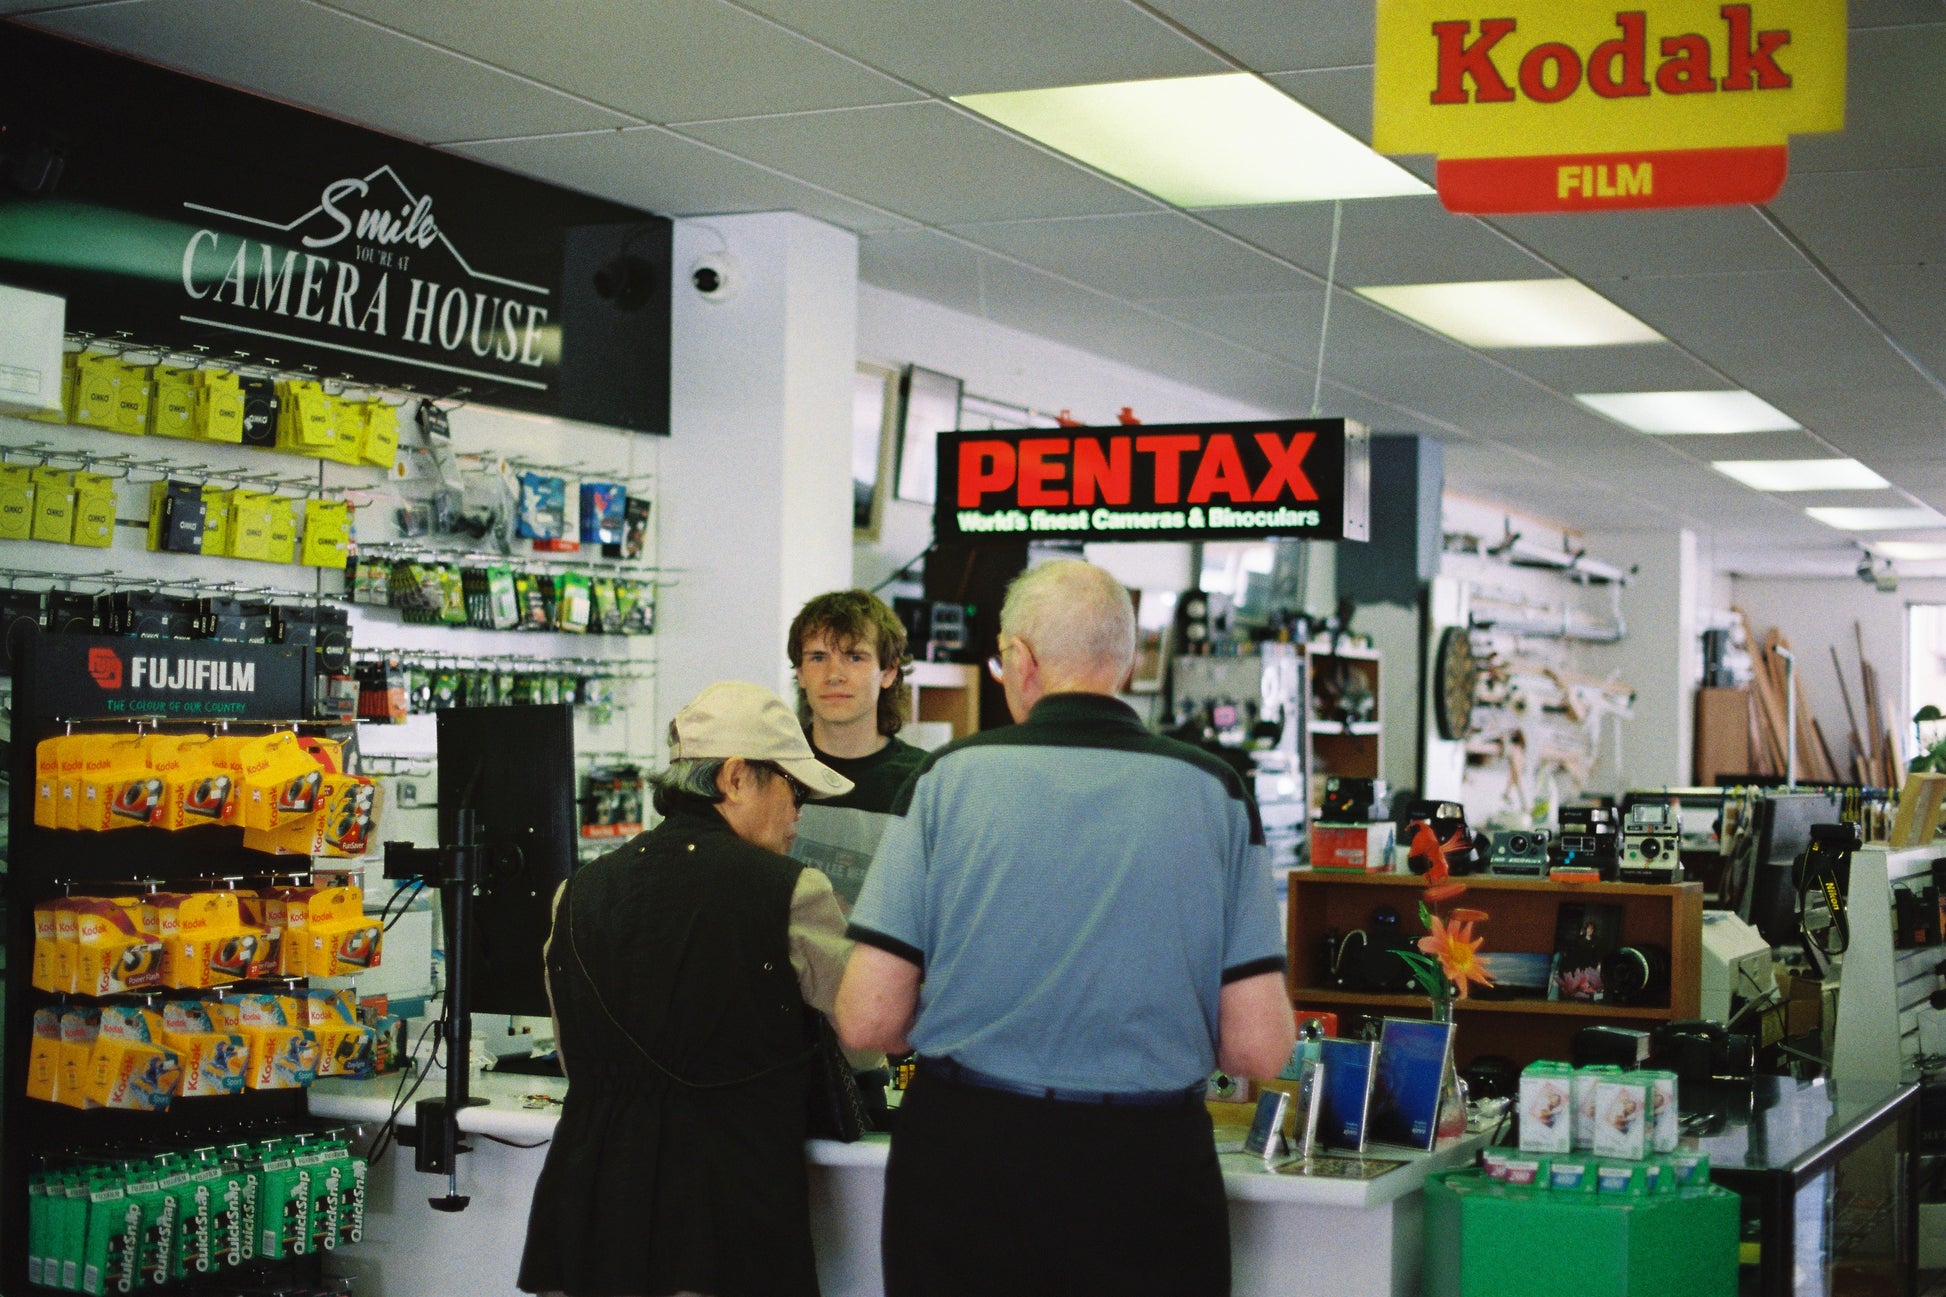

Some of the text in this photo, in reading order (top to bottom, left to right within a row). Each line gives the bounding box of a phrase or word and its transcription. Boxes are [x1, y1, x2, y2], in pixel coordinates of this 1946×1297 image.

[1430, 3, 1793, 106] Kodak
[1557, 162, 1653, 199] FILM
[302, 178, 438, 250] Smile
[356, 244, 411, 272] YOU'RE AT
[182, 229, 549, 368] CAMERA HOUSE
[957, 432, 1320, 508] PENTAX
[957, 505, 1320, 532] World's finest Cameras & Binoculars
[131, 656, 256, 692] FUJIFILM
[107, 699, 247, 714] THE COLOUR OF OUR COUNTRY
[61, 761, 83, 772] Koda
[86, 760, 112, 772] Kodak
[155, 760, 180, 772] Kodak
[246, 760, 271, 775] Kodak
[102, 784, 114, 829] Kodak
[176, 784, 185, 828] Kodak
[270, 785, 279, 827] Kodak
[314, 814, 327, 853] Kodak
[1825, 882, 1840, 911] Nikon
[82, 923, 107, 936] Kodak
[182, 919, 207, 930] Kodak
[311, 911, 334, 922] Kodak
[100, 950, 112, 993] Kodak
[201, 942, 211, 986] Kodak
[330, 934, 339, 976] Kodak
[224, 1017, 240, 1026] Kod
[242, 1012, 261, 1021] Kodak
[311, 1010, 333, 1020] Kodak
[187, 1042, 202, 1091] Kodak
[261, 1037, 276, 1084] Kodak
[322, 1033, 336, 1073] Kodak
[113, 1056, 134, 1102] Kodak
[351, 1160, 367, 1243] QuickSn
[118, 1203, 141, 1293] QuickSnp
